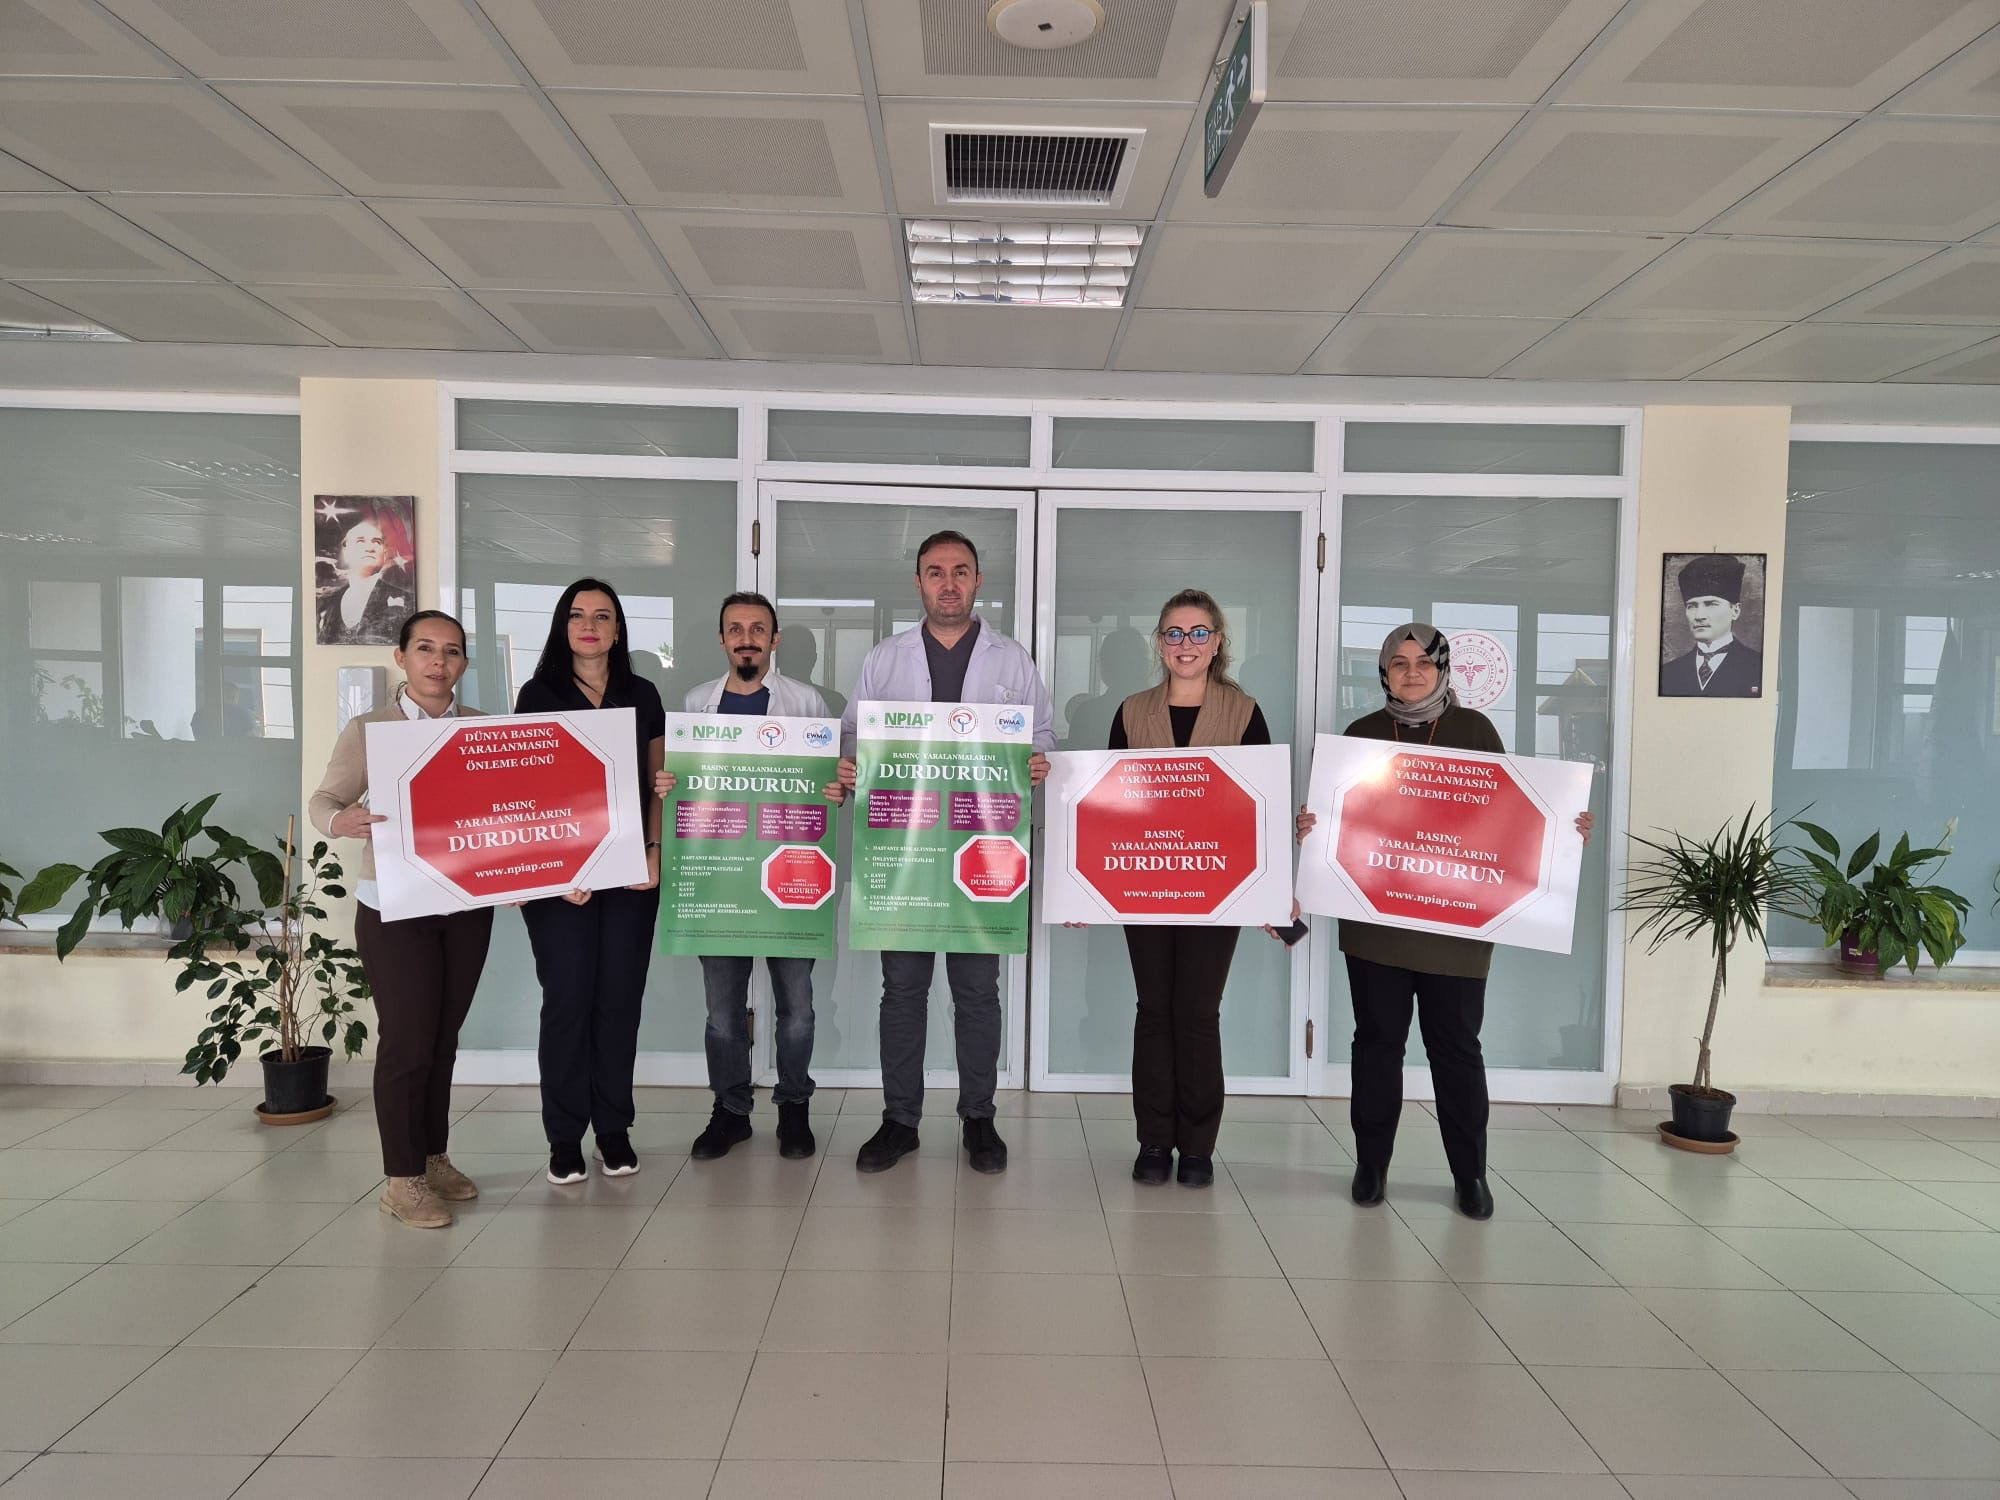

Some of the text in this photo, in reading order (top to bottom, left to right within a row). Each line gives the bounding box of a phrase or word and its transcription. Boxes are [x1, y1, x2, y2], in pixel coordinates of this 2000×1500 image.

[884, 712, 934, 727] NPIAP
[999, 718, 1020, 726] EWMA
[464, 727, 554, 742] DÜNYA BASINÇ
[692, 725, 742, 740] NPIAP
[806, 732, 828, 740] EWMA
[459, 739, 560, 755] YARALANMASINI
[466, 754, 555, 771] ÖNLEME GÜNÜ
[892, 752, 996, 761] BASINÇ YARALANMALARINI
[702, 764, 803, 774] BASINÇ YARALANMALARINI
[879, 763, 1009, 782] DURDURUN!
[1123, 762, 1205, 773] DÜNYA BASINÇ
[1402, 758, 1495, 777] DÜNYA BASINÇ
[687, 775, 815, 794] DURDURUN!
[1118, 773, 1210, 784] YARALANMASINI
[1395, 769, 1499, 790] YARALANMASINI
[1123, 788, 1205, 799] ÖNLEME GÜNÜ
[1398, 784, 1490, 805] ÖNLEME GÜNÜ
[492, 799, 536, 812] BASINÇ
[455, 807, 572, 829] YARALANMALARINI
[448, 821, 582, 852] DURDURUN
[1144, 829, 1185, 840] BASINÇ
[1416, 830, 1462, 845] BASINÇ
[1111, 841, 1219, 850] YARALANMALARINI
[1378, 838, 1499, 862] YARALANMALARINI
[475, 859, 564, 878] www.npiap.com
[1103, 855, 1228, 872] DURDURUN
[1366, 851, 1505, 885] DURDURUN
[970, 879, 1015, 887] DURDURUN
[777, 887, 821, 895] DURDURUN
[1123, 889, 1206, 899] www.npiap.com
[1386, 888, 1477, 910] www.npiap.com
